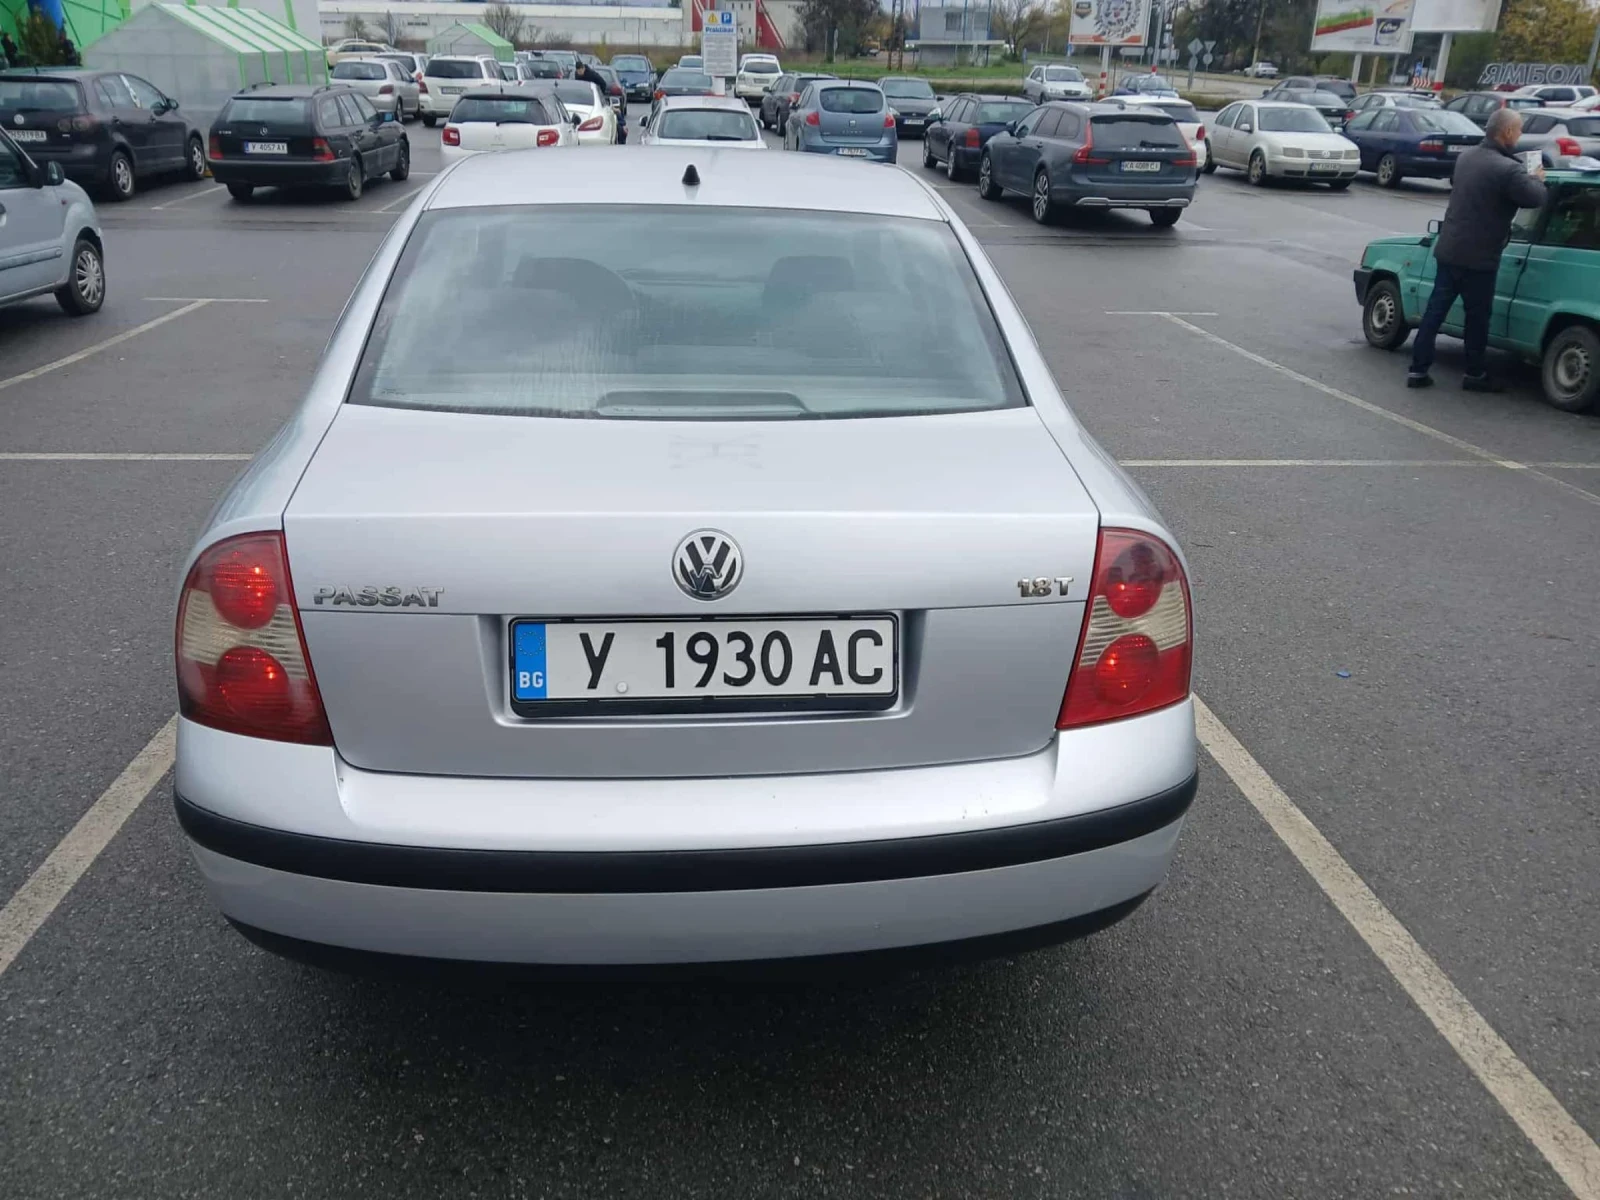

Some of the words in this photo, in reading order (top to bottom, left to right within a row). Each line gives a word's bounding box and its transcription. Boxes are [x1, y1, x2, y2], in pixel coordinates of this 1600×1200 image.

[1477, 63, 1590, 85] ЯМБОЛ
[313, 585, 445, 608] PASSAT
[519, 671, 544, 688] BG
[656, 630, 793, 688] 1930
[809, 629, 883, 686] AC
